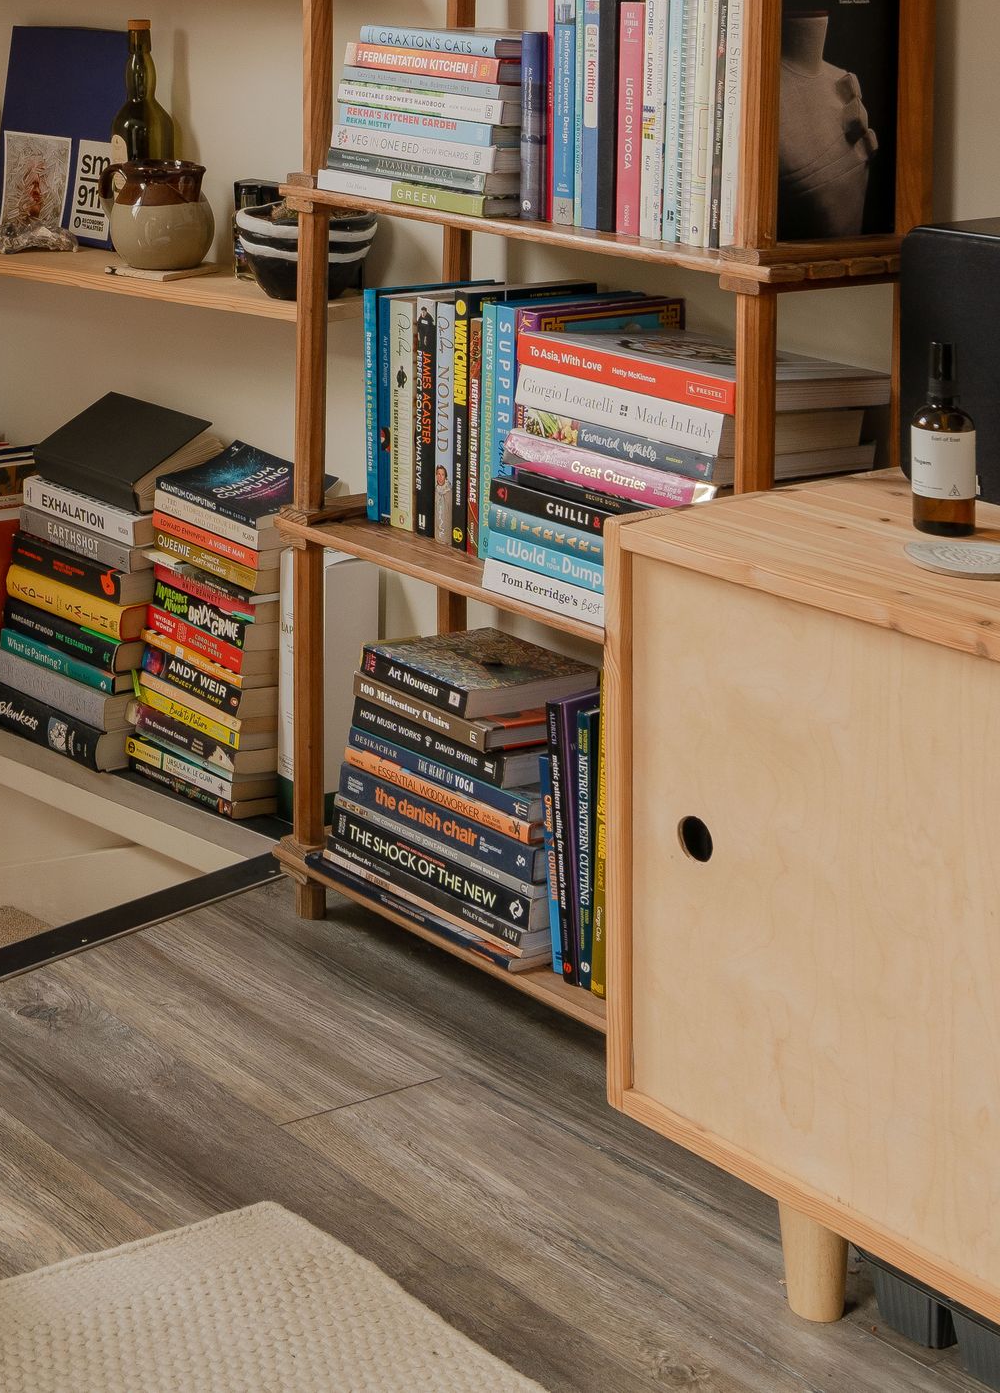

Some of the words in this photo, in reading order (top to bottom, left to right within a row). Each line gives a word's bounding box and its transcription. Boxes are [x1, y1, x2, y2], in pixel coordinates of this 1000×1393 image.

[379, 32, 442, 50] CRAXTON'S
[444, 40, 473, 54] CATS
[363, 52, 428, 68] FERMENTATION
[429, 60, 468, 74] KITCHEN
[586, 60, 596, 103] Knitting
[625, 78, 634, 111] LIGHT
[355, 90, 384, 101] VEGETABLE
[385, 94, 413, 104] GROWER'S
[414, 98, 446, 108] HANDBOOK
[346, 107, 381, 120] REKHA'S
[384, 112, 419, 125] KITCHEN
[422, 117, 457, 130] GARDEN
[346, 117, 366, 125] REKHA
[368, 120, 391, 129] MISTRY
[624, 114, 634, 134] ON
[624, 136, 634, 169] YOGA
[396, 190, 437, 204] GREEN
[82, 218, 104, 226] RECORDING
[485, 317, 494, 370] AINSLEY'S
[530, 346, 540, 356] To
[540, 348, 560, 364] Asia,
[558, 353, 581, 368] With
[582, 359, 602, 372] Love
[422, 351, 432, 389] JAMES
[454, 319, 468, 406] WATCHMEN
[612, 367, 629, 378] Hetty
[628, 370, 656, 384] McKinnon
[436, 364, 450, 452] NOMAD
[470, 379, 478, 426] EVERYTHING
[522, 378, 562, 401] Giorgio
[564, 388, 614, 414] Locatelli
[696, 386, 722, 399] PRESTEL
[422, 392, 432, 444] ACASTER
[470, 428, 478, 437] IN
[484, 372, 493, 460] MEDITERRANEAN
[634, 405, 668, 427] Made
[670, 414, 683, 431] In
[686, 418, 714, 443] Italy
[212, 466, 275, 494] QUANTUM
[217, 466, 289, 499] COMPUTING
[571, 461, 601, 479] Great
[604, 470, 647, 491] Curries
[160, 482, 186, 498] QUANTUM
[185, 491, 216, 510] COMPUTING
[482, 464, 492, 526] COOKBOOK
[42, 494, 104, 530] EXHALATION
[546, 502, 589, 525] CHILLI
[47, 522, 99, 552] EARTHSHOT
[158, 534, 190, 558] QUEENIE
[506, 538, 545, 566] World
[164, 599, 188, 614] ATWOOD
[501, 572, 523, 588] Tom
[524, 580, 578, 606] Kerridge's
[580, 599, 600, 614] Best
[154, 614, 176, 629] INVISIBLE
[156, 621, 174, 634] WOMEN
[188, 604, 211, 628] ORYX
[211, 616, 240, 643] CRAKE
[7, 636, 24, 652] What
[25, 643, 30, 655] is
[32, 646, 62, 671] Painting?
[168, 660, 198, 682] ANDY
[200, 674, 227, 699] WEIR
[168, 674, 192, 689] PROJECT
[192, 686, 206, 696] HAIL
[206, 694, 222, 706] MARY
[388, 666, 402, 680] Art
[402, 672, 439, 697] Nouveau
[169, 703, 183, 718] Back
[183, 710, 190, 722] to
[188, 710, 208, 731] Nature
[360, 682, 375, 696] 100
[376, 688, 421, 718] Midcentury
[422, 709, 450, 730] Chairs
[359, 709, 376, 722] HOW
[376, 716, 397, 732] MUSIC
[398, 725, 422, 742] WORKS
[354, 734, 398, 758] DESIKACHAR
[434, 740, 455, 757] DAVID
[456, 750, 478, 766] BYRNE
[377, 764, 418, 790] ESSENTIAL
[418, 784, 480, 820] WOODWORKER
[418, 758, 430, 772] THE
[430, 762, 445, 780] HEART
[446, 770, 454, 782] OF
[454, 773, 474, 794] YOGA
[578, 754, 588, 798] METRIC
[375, 786, 394, 811] the
[398, 798, 439, 832] danish
[443, 820, 478, 847] chair
[579, 800, 589, 852] PATTERN
[349, 824, 372, 848] THE
[374, 835, 416, 870] SHOCK
[418, 856, 436, 878] OF
[438, 866, 461, 892] THE
[464, 882, 496, 908] NEW
[580, 854, 590, 905] CUTTING
